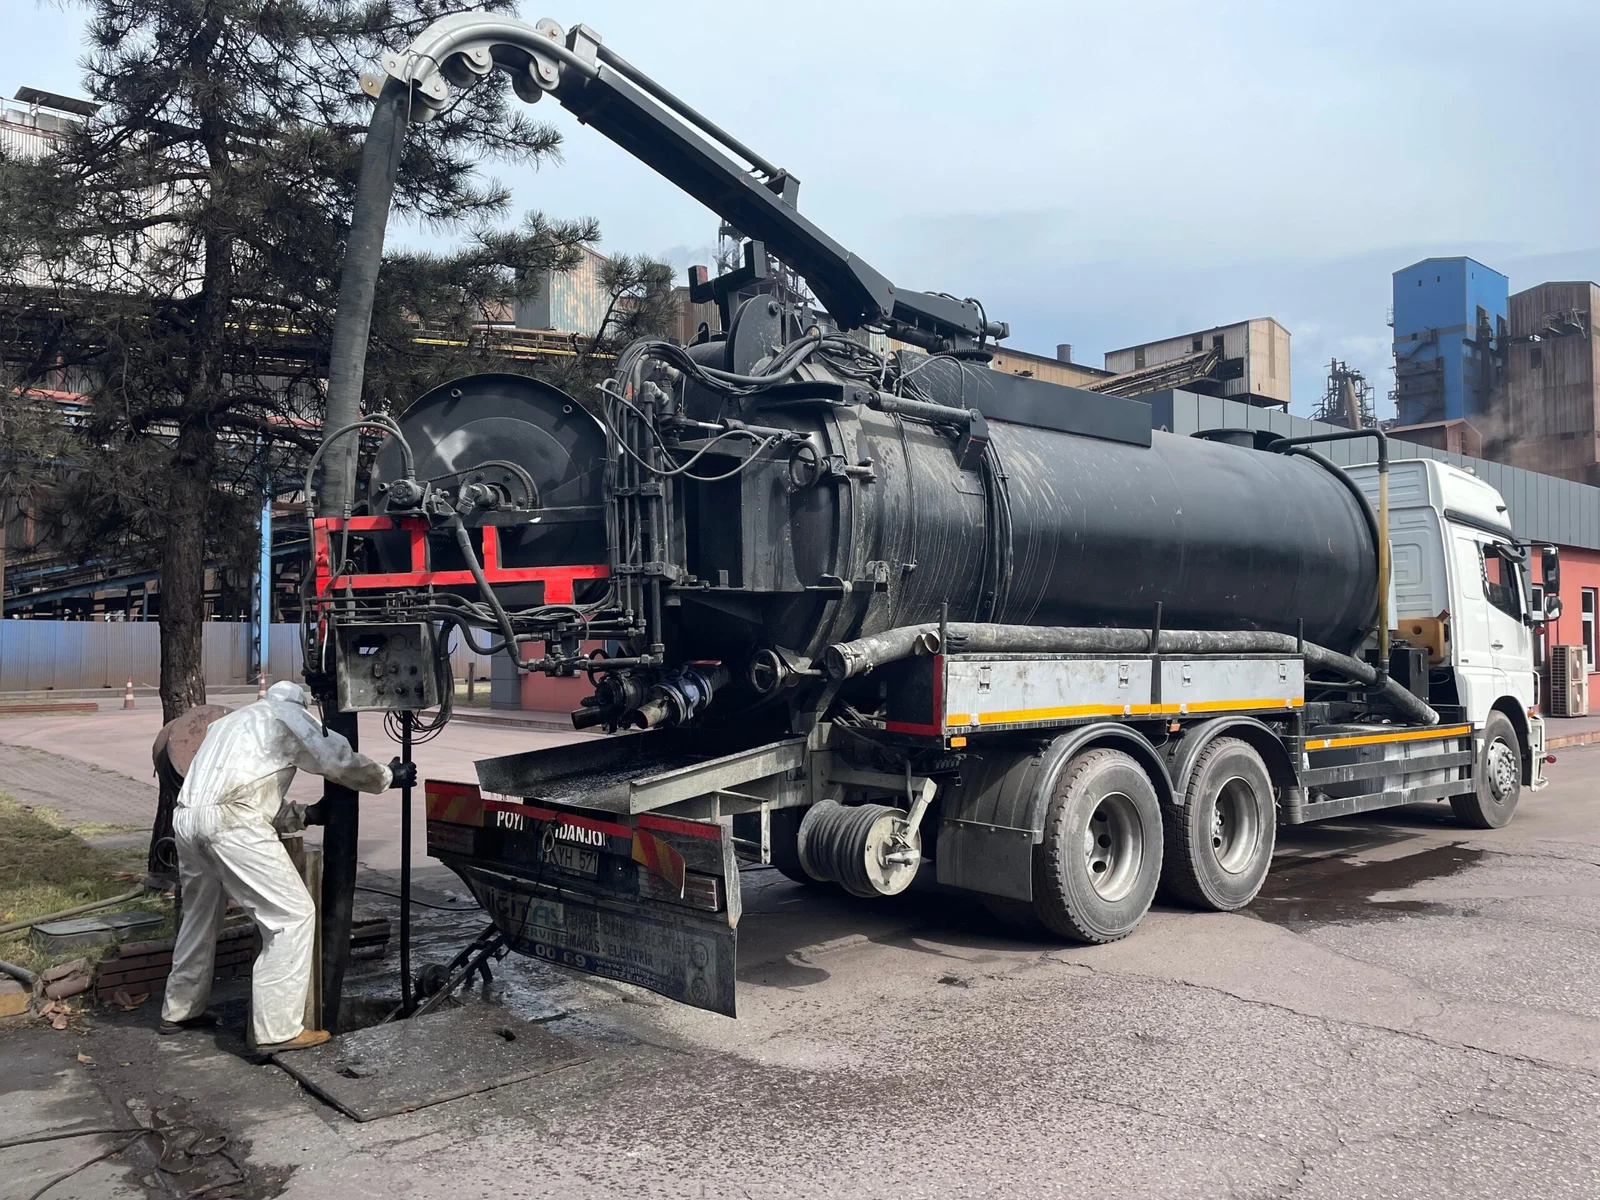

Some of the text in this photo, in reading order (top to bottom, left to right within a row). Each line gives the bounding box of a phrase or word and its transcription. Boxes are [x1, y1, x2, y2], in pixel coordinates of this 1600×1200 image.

[580, 850, 597, 873] 571
[535, 943, 556, 960] 00
[563, 951, 586, 968] 69
